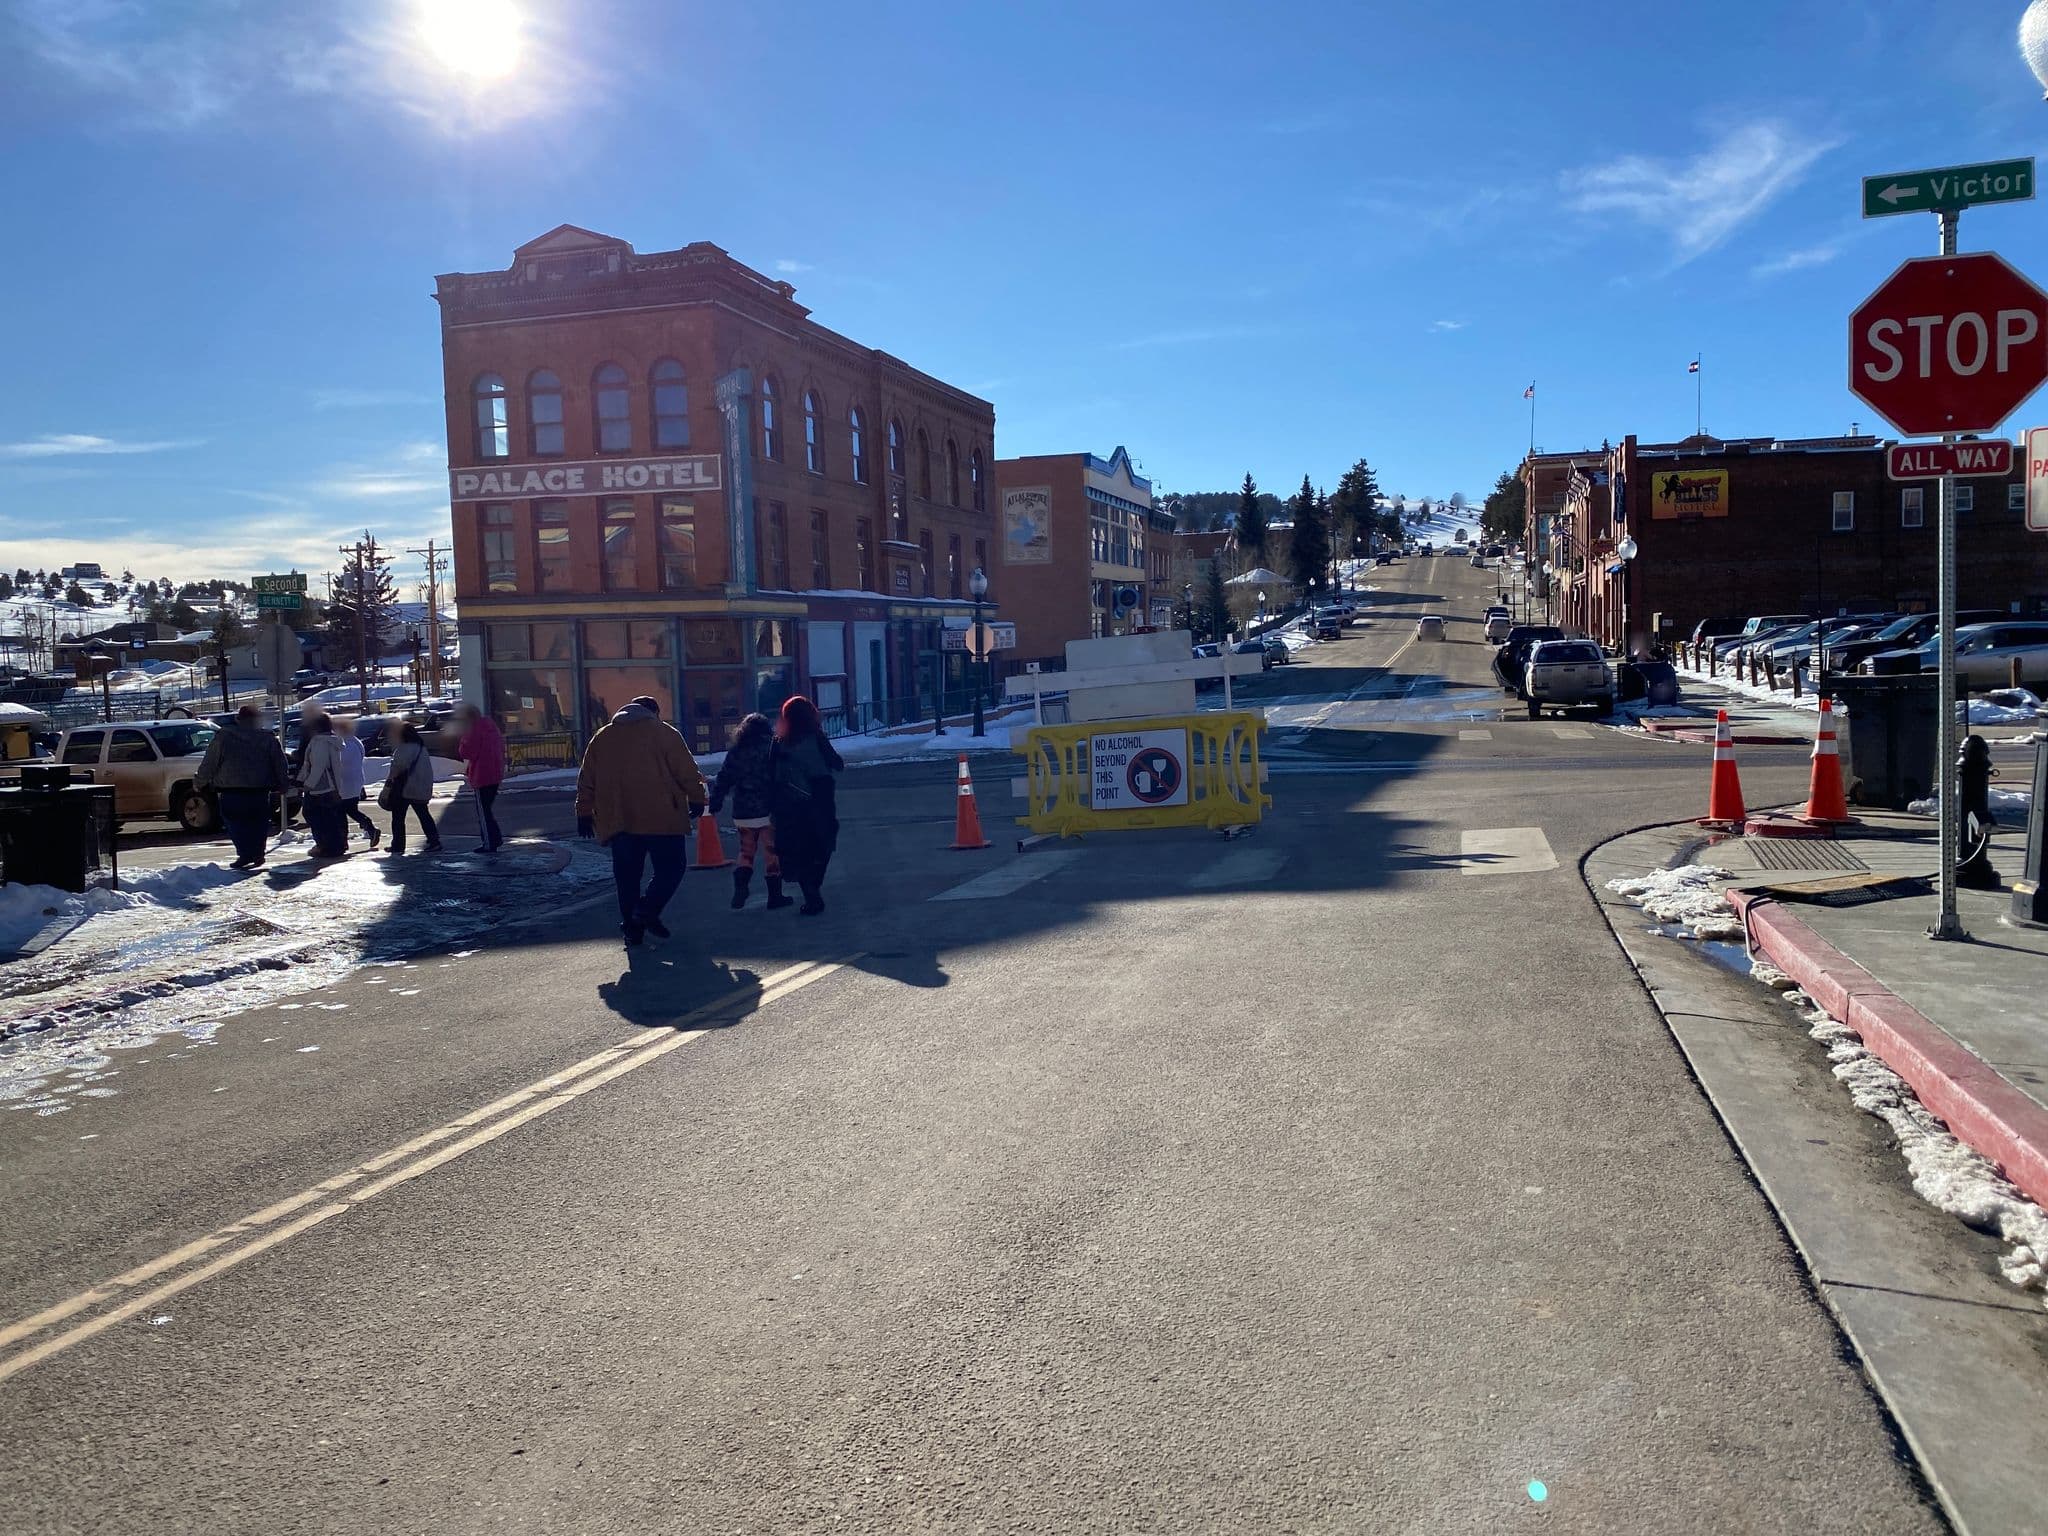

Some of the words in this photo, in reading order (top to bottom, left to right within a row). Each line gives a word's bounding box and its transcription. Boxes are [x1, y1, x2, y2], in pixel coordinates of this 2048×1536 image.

[1930, 172, 2026, 199] Victor
[1863, 308, 2038, 382] STOP
[1900, 451, 1942, 471] ALL
[1955, 447, 2001, 468] WAY
[457, 468, 585, 496] PALACE
[602, 462, 714, 488] HOTEL
[264, 576, 297, 592] Second
[1095, 739, 1106, 751] NO
[1108, 736, 1143, 750] ALCOHOL
[1095, 754, 1127, 768] BEYOND
[1096, 771, 1113, 784] THIS
[1096, 787, 1120, 800] POINT
